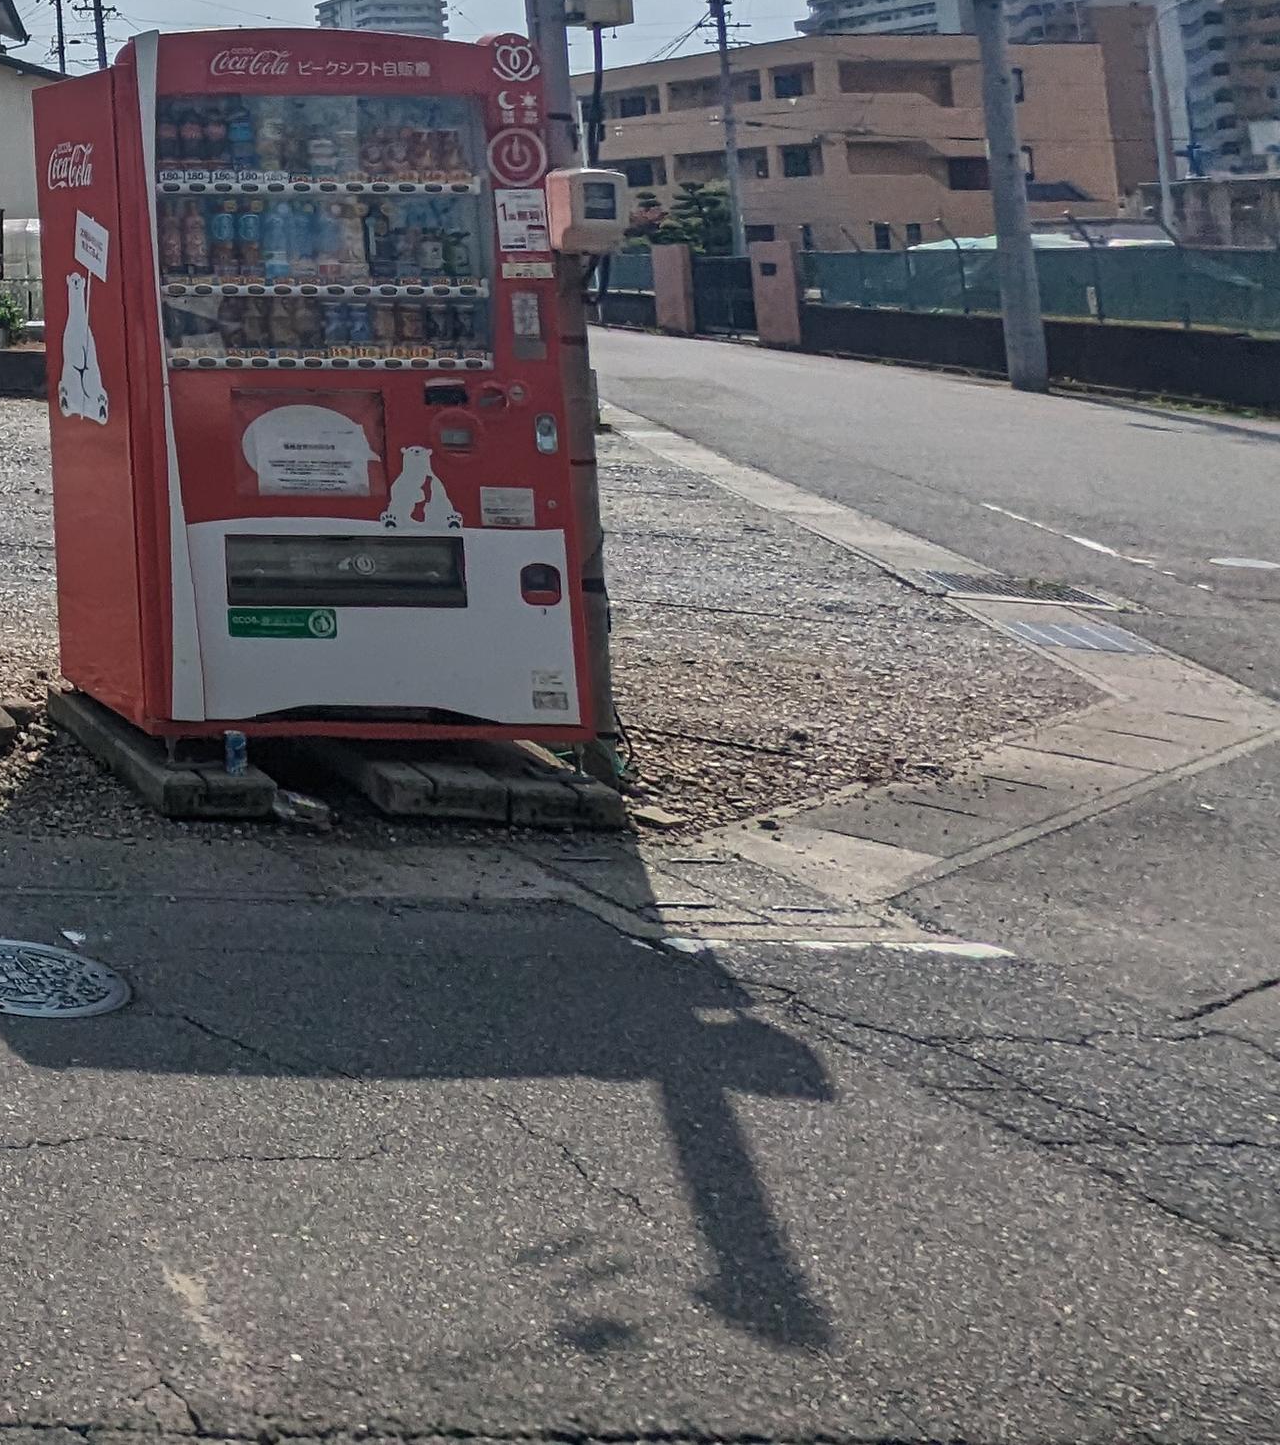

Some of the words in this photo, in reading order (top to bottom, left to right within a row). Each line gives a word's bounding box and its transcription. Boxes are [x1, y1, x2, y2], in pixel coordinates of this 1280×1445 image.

[211, 49, 291, 76] Coca-Cola
[297, 60, 432, 78] ピークシフト自販機
